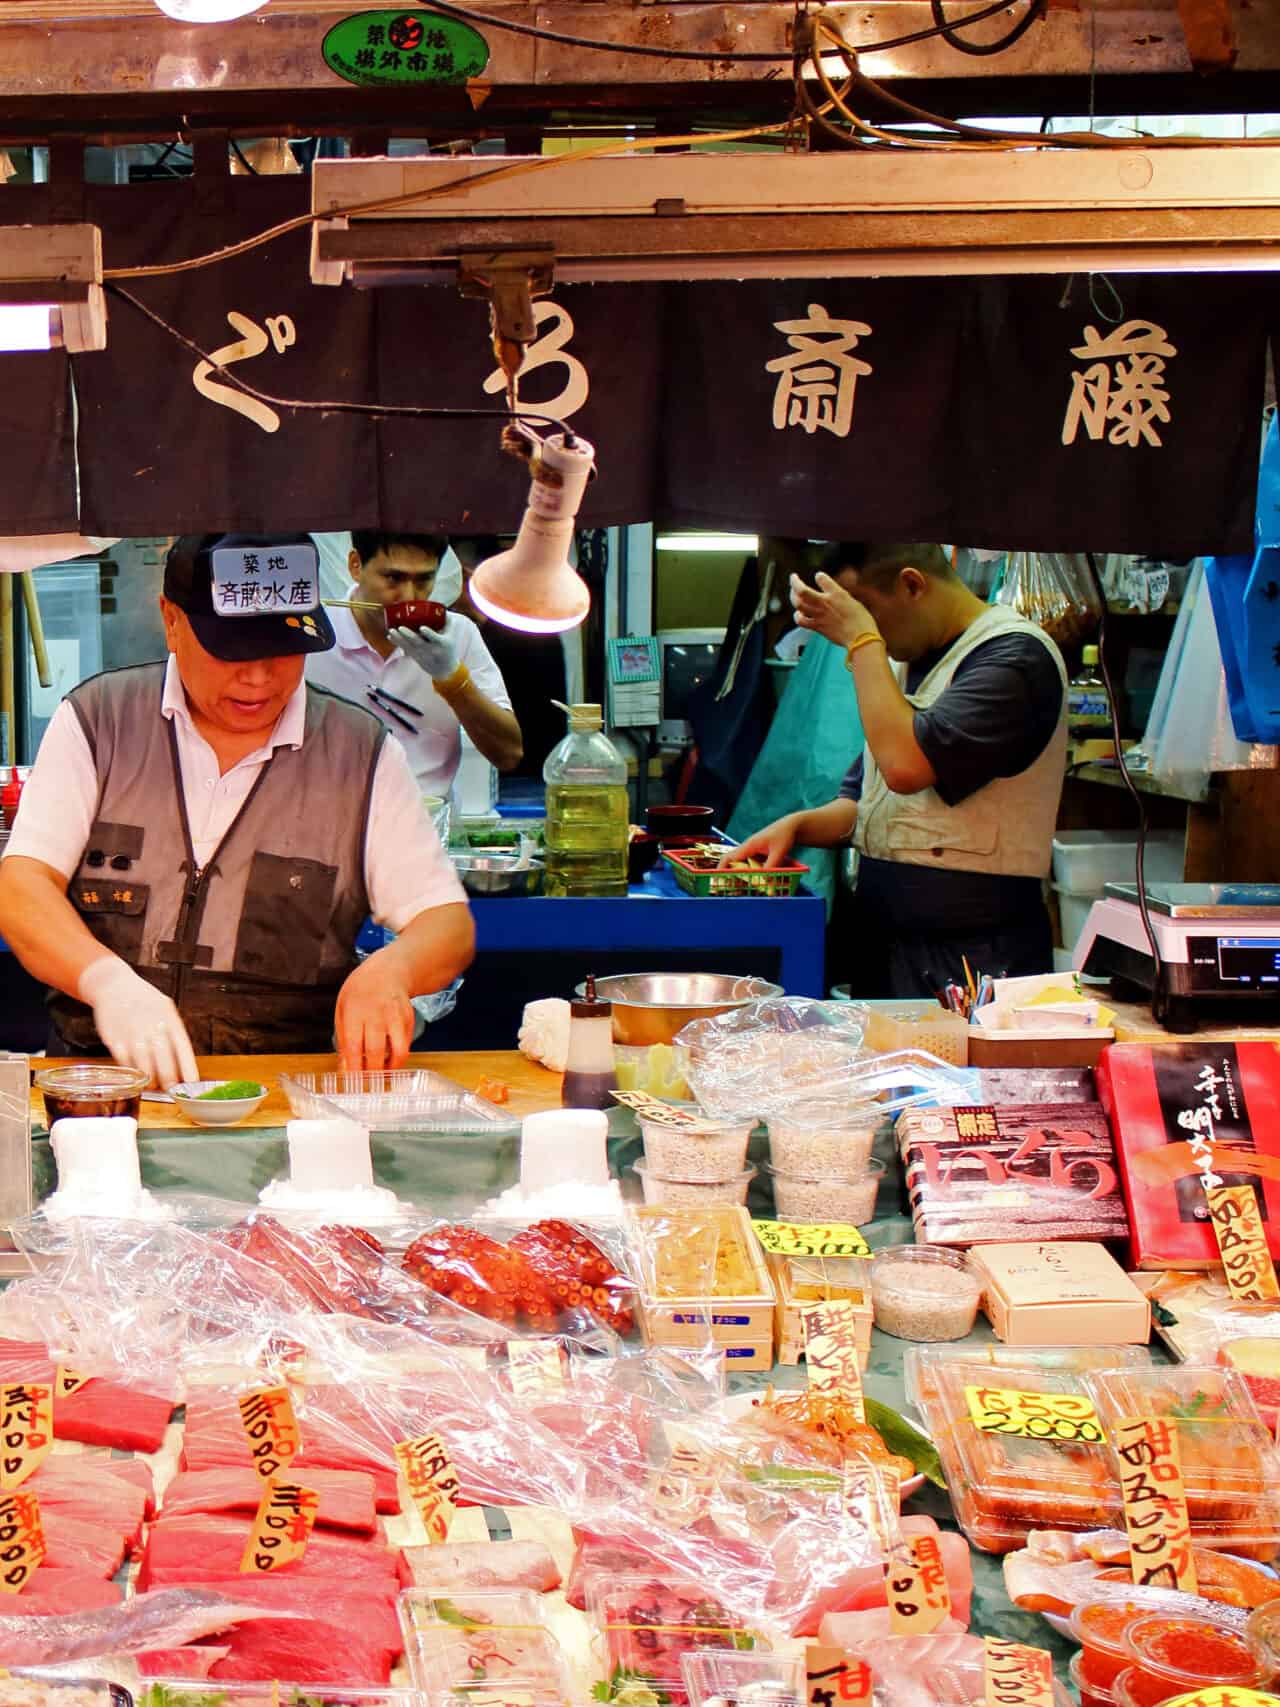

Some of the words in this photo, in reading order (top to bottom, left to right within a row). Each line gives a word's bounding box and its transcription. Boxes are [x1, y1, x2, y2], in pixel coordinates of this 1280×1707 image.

[243, 554, 289, 579] 築地
[919, 1129, 1118, 1202] いくら
[976, 1388, 1097, 1420] たらこ
